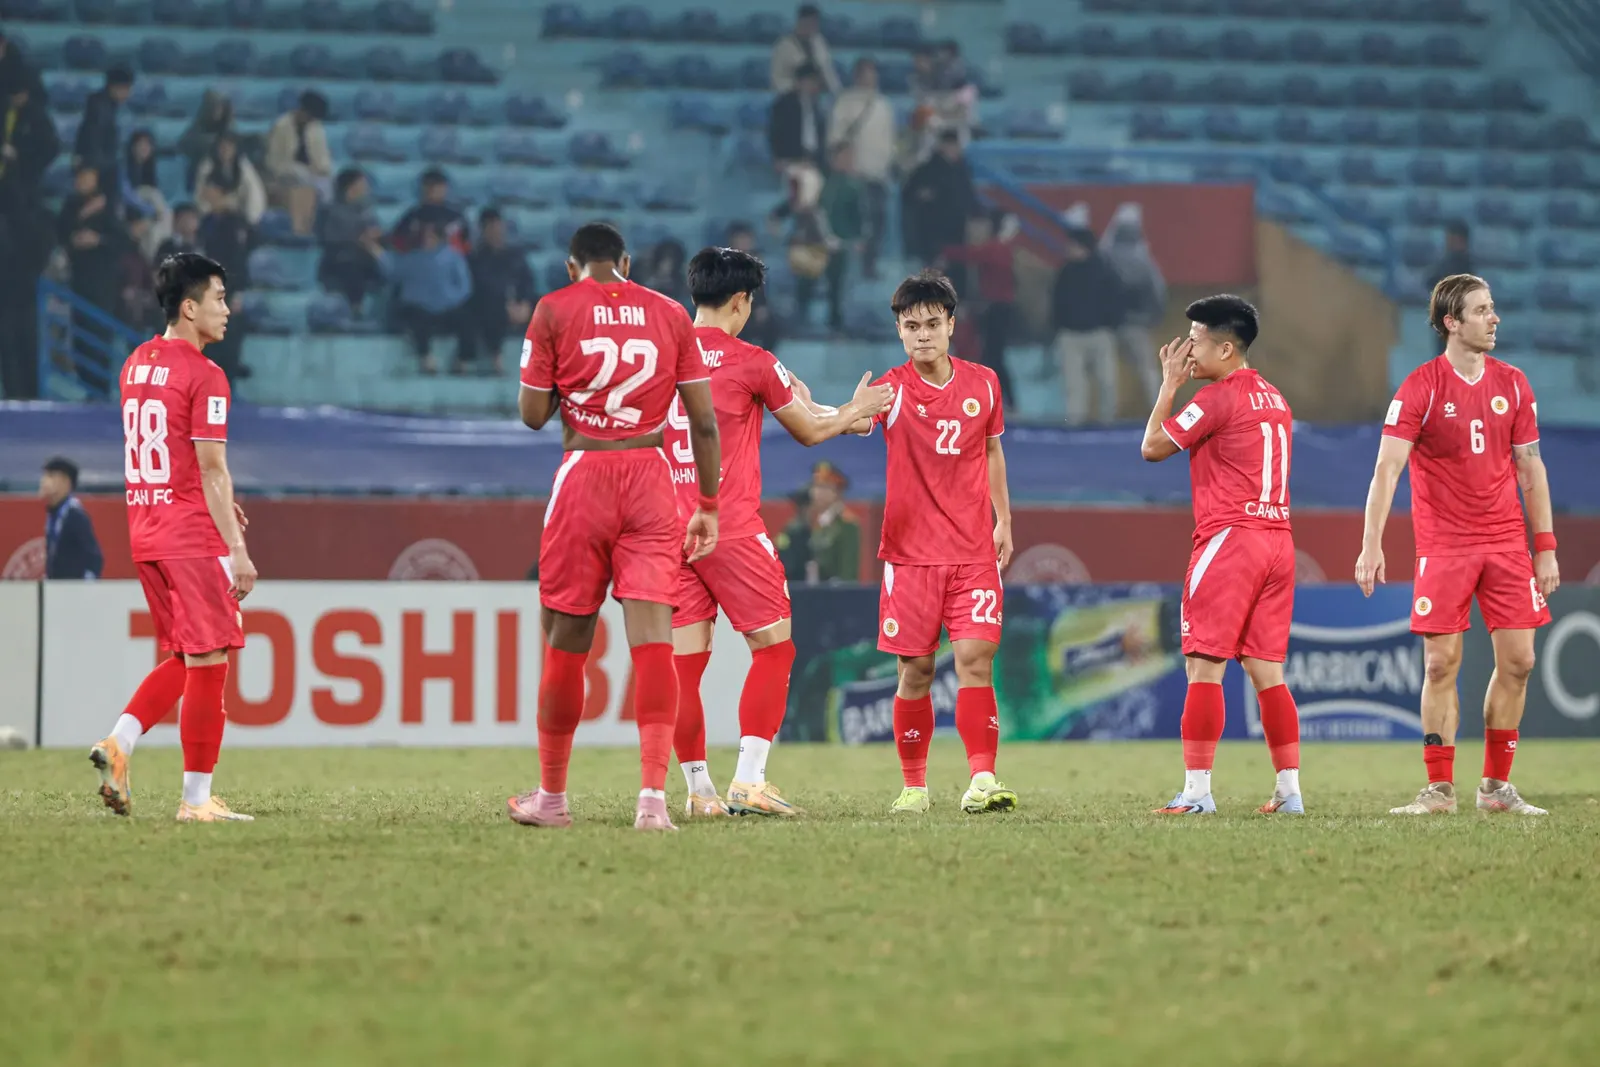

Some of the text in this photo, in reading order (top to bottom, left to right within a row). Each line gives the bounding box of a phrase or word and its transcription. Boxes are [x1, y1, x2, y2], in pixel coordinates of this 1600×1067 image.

[592, 304, 646, 327] ALAN
[123, 397, 171, 484] 88
[935, 419, 961, 455] 22
[1469, 419, 1485, 455] 6
[1259, 421, 1288, 504] 11
[152, 487, 174, 506] FC
[971, 588, 997, 625] 22
[129, 608, 636, 727] OSHIB
[1284, 646, 1423, 695] ARBICAN
